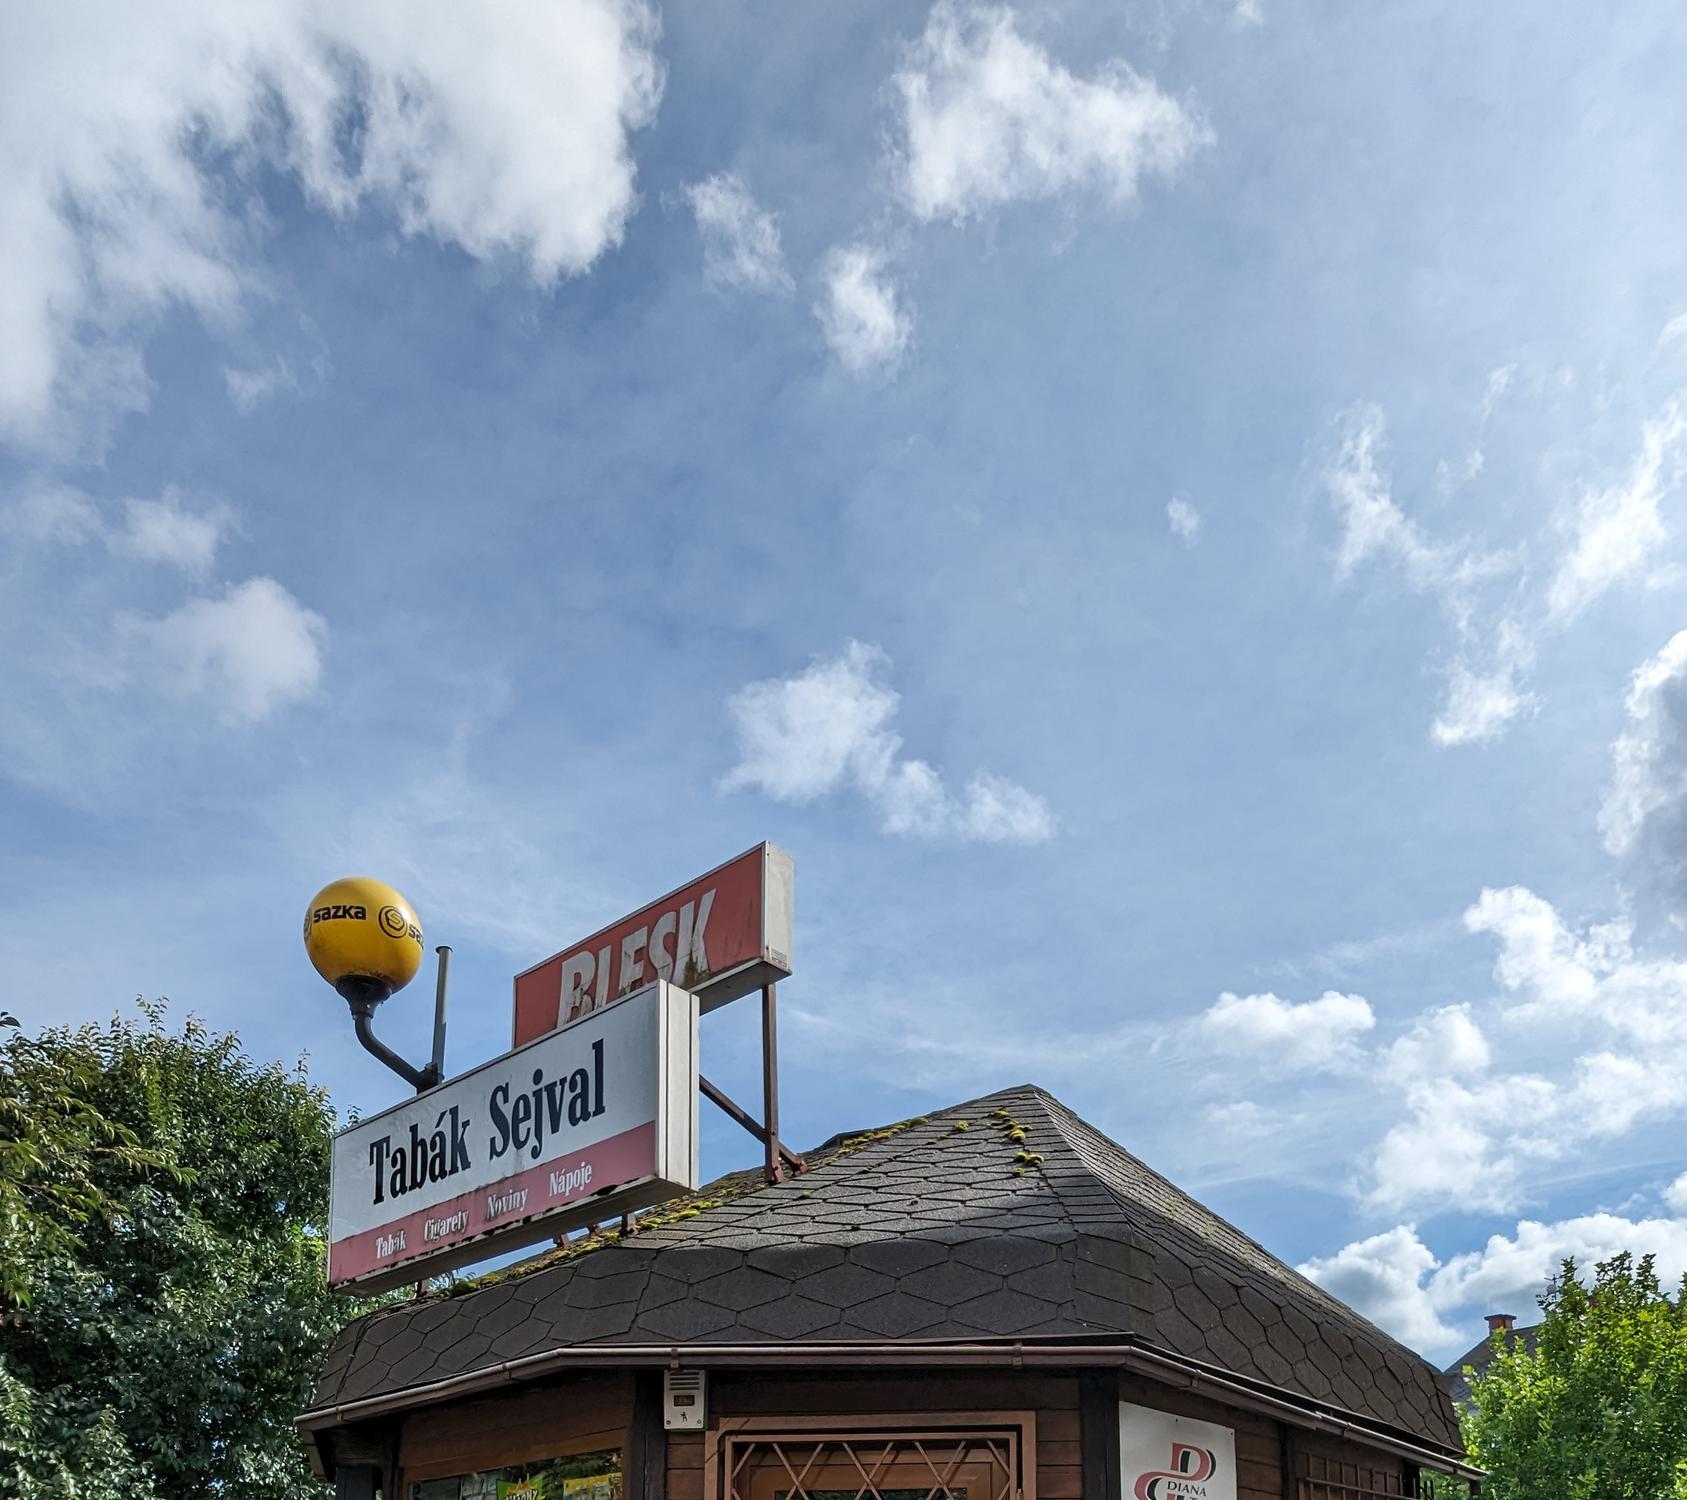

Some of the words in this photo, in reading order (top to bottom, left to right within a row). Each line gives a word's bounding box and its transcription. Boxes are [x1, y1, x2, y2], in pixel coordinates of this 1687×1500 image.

[556, 888, 717, 1029] BLESK
[369, 1105, 471, 1205] Tabák
[489, 1038, 606, 1161] Sejval
[375, 1230, 407, 1259] Tabák
[424, 1209, 470, 1243] Cigarety
[486, 1188, 529, 1221] Noviny
[549, 1161, 592, 1197] Nápoje
[1167, 1481, 1207, 1497] DIANA
